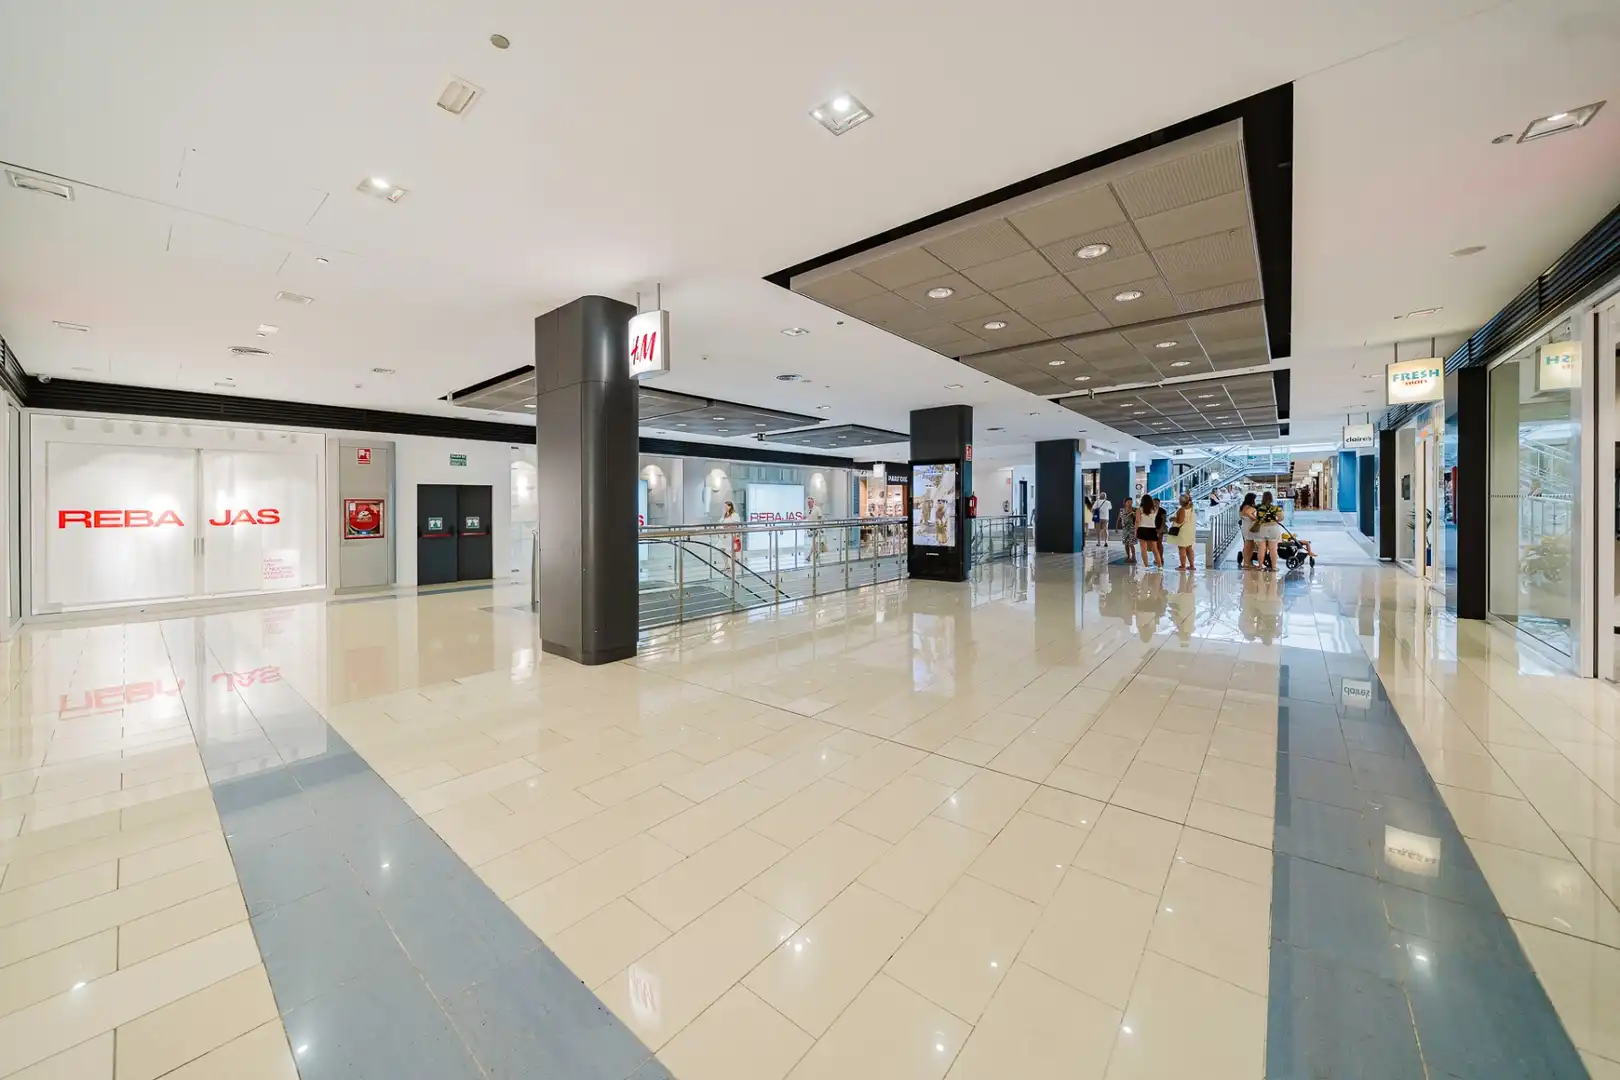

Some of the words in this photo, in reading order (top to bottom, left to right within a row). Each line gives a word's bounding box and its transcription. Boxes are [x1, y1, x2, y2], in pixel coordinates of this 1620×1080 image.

[631, 331, 657, 365] H&M
[1392, 368, 1440, 382] FRESH
[58, 509, 184, 529] REBA
[209, 508, 281, 526] JAS
